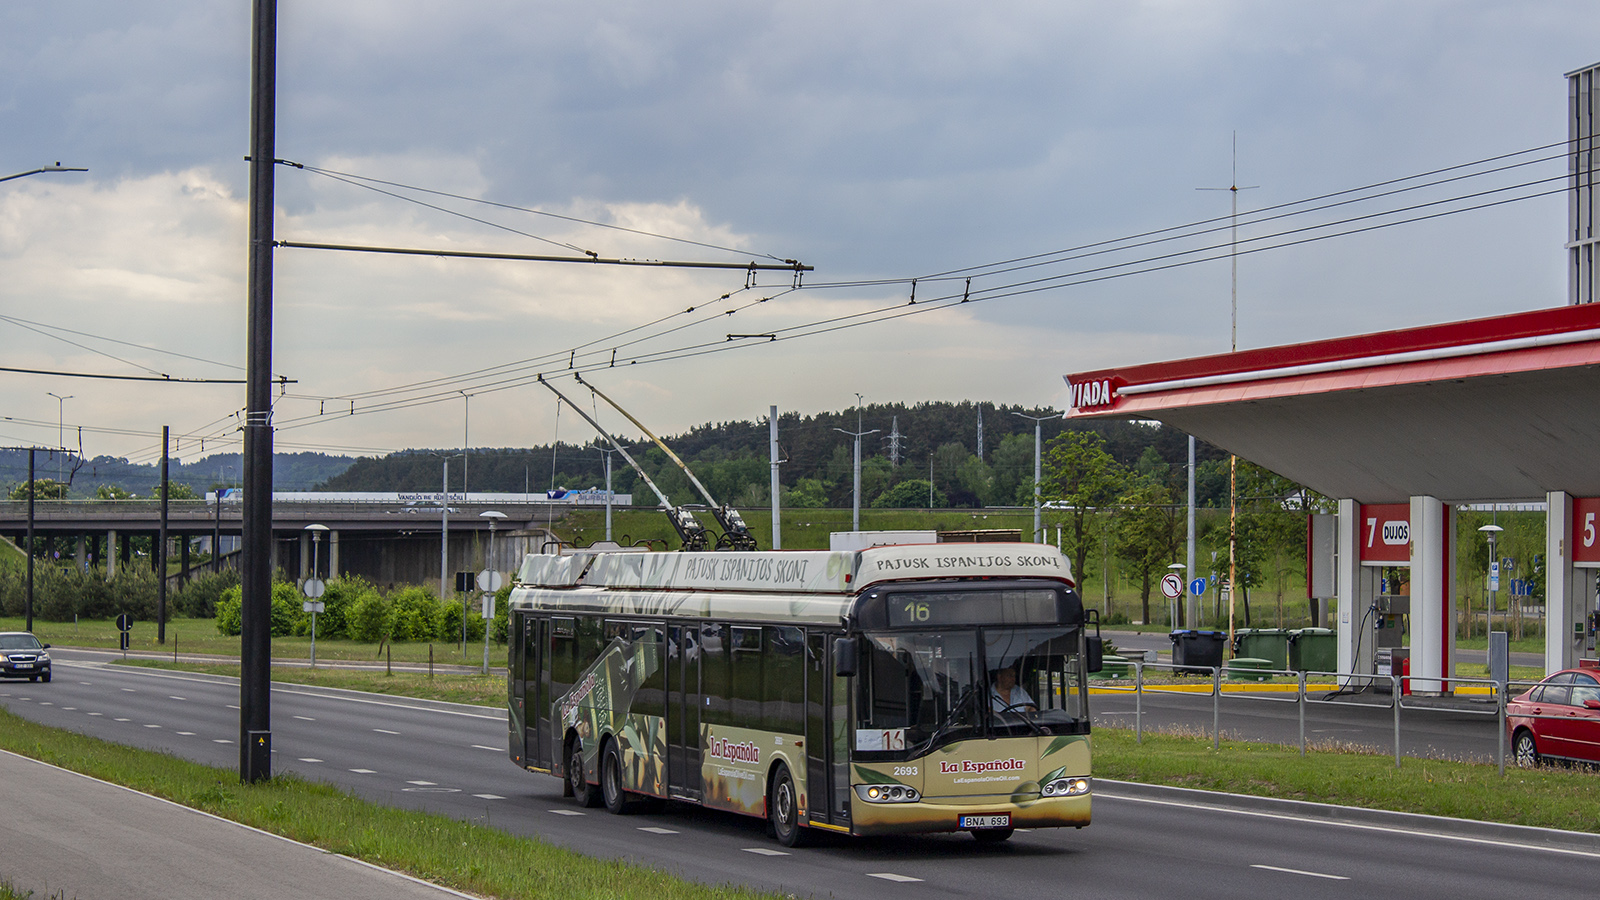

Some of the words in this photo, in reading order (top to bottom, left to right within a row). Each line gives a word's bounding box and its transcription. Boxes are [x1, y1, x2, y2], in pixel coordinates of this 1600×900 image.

[1069, 380, 1110, 407] VIADA
[1367, 517, 1377, 548] 7
[1384, 525, 1408, 540] DUJOS
[1583, 512, 1595, 547] 5
[685, 557, 719, 581] PAJUSK
[720, 558, 773, 582] ISPANIJOS
[774, 559, 809, 588] SKONĮ
[877, 558, 930, 570] PAJUSK
[935, 556, 1012, 568] ISPANIJOS
[1017, 556, 1060, 569] SKONĮ
[904, 601, 930, 622] 16
[710, 736, 721, 758] La
[722, 738, 759, 764] Española
[883, 731, 903, 750] 16
[894, 766, 918, 776] 2693
[940, 761, 959, 773] La
[962, 758, 1025, 774] Española
[965, 817, 985, 827] BNA
[990, 816, 1008, 826] 693
